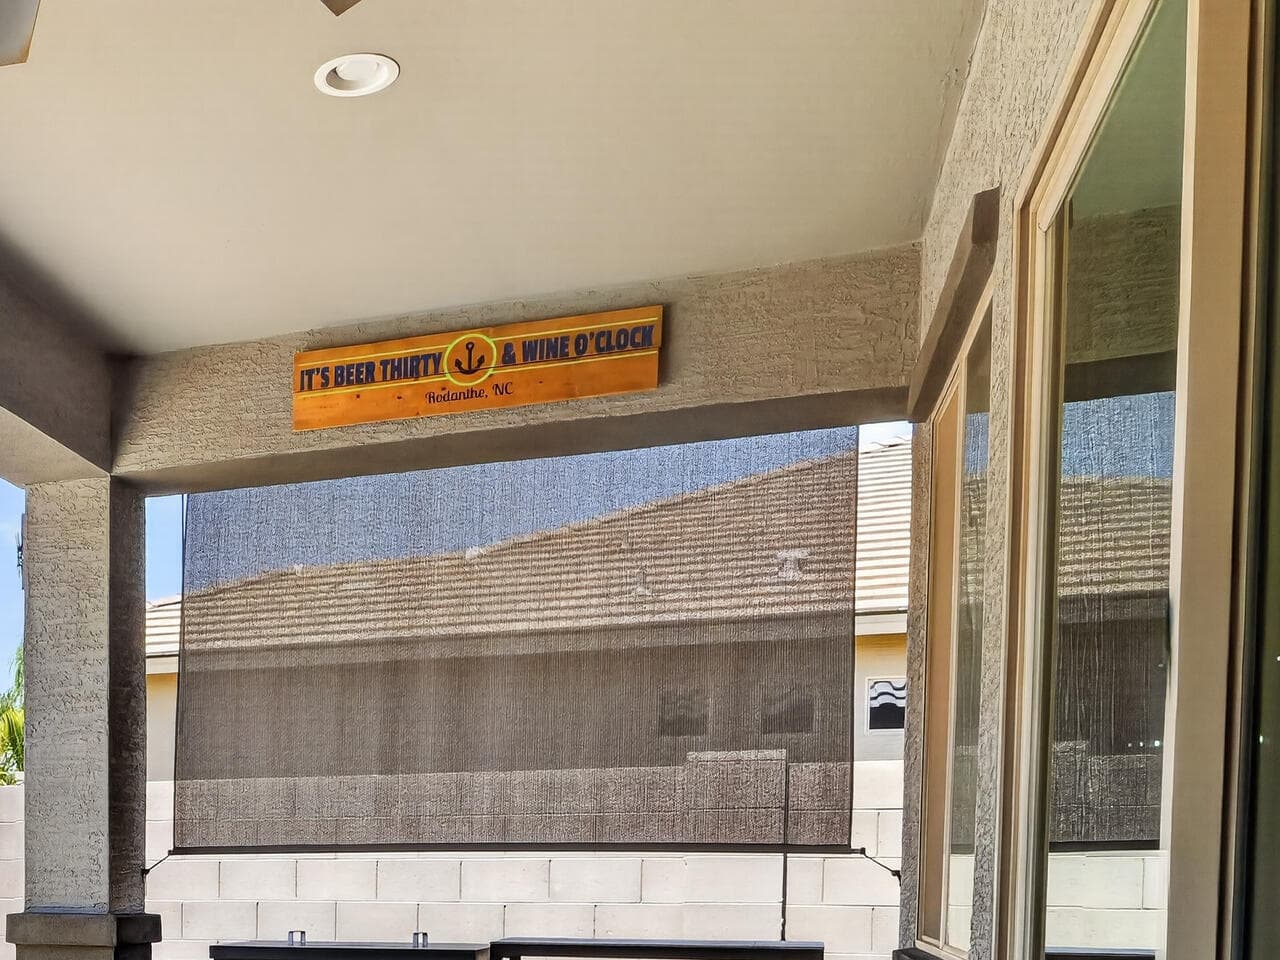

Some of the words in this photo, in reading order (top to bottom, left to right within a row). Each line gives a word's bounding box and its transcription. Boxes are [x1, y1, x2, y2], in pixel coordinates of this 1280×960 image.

[300, 366, 330, 391] IT'S
[334, 361, 376, 387] BEER
[380, 352, 442, 380] THIRTY
[501, 342, 517, 364] &
[522, 335, 570, 362] WINE
[574, 325, 655, 355] O'CLOCK
[425, 388, 488, 404] Rodanthe,
[492, 381, 514, 396] NC
